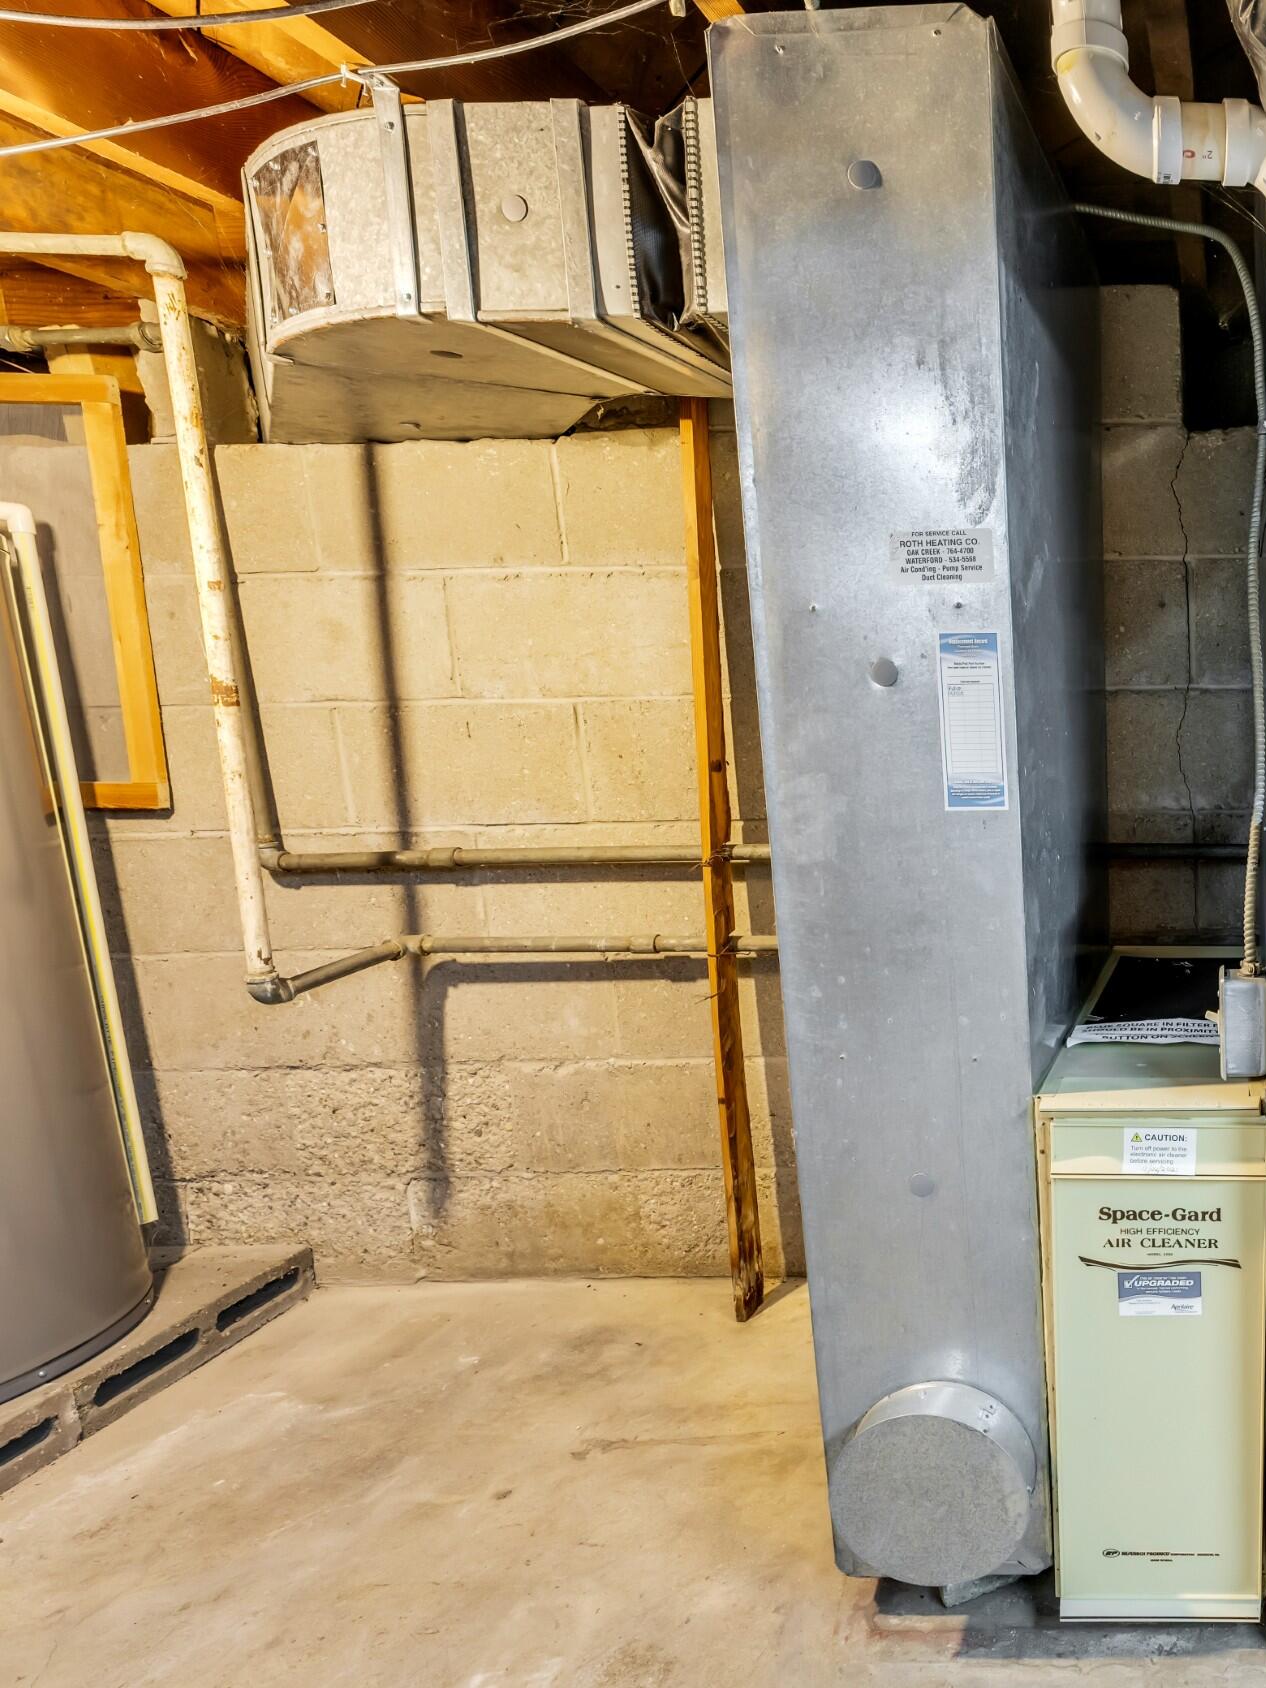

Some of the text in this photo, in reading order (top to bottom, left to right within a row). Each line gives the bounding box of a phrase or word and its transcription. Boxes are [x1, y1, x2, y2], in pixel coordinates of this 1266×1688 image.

[900, 537, 980, 548] ROTH HEATING CO.
[920, 548, 941, 556] CREEK
[905, 557, 943, 565] WATERFORD
[942, 565, 959, 573] Pump
[960, 564, 983, 572] Service
[936, 573, 963, 581] Cleaning
[1144, 1133, 1188, 1142] CAUTION:
[1098, 1206, 1222, 1225] Space-Gard
[1119, 1227, 1200, 1236] HIGH EFFICIENCY
[1103, 1237, 1219, 1249] AIR CLEANER
[1134, 1279, 1195, 1287] UPGRADED
